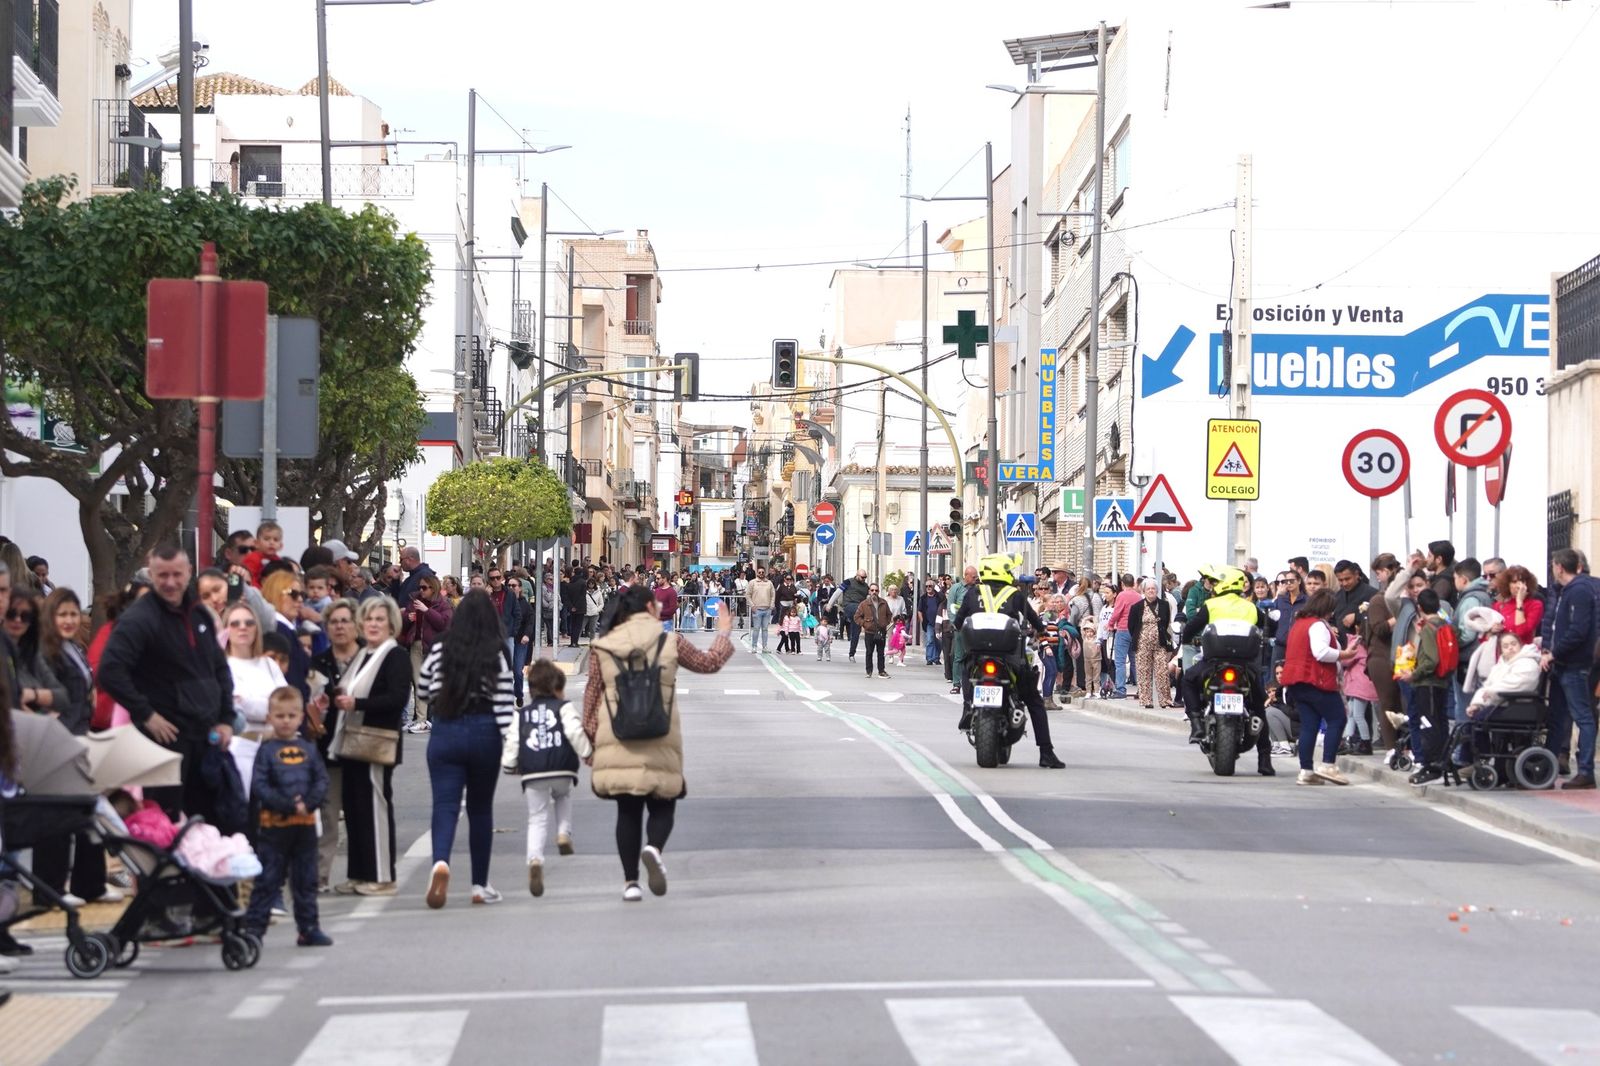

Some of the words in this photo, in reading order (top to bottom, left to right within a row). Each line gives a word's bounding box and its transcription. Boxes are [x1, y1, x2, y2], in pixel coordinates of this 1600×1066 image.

[1216, 303, 1325, 322] Eosición
[1332, 309, 1343, 326] y
[1347, 305, 1404, 323] Venta
[1217, 345, 1396, 390] uebles
[1487, 377, 1529, 396] 950
[1041, 353, 1055, 461] MUEBLES
[1211, 423, 1258, 434] ATENCIÓN
[1357, 451, 1396, 474] 30
[1002, 466, 1053, 480] VERA
[1210, 485, 1256, 495] COLEGIO
[1071, 493, 1083, 510] L
[981, 687, 1001, 697] 8367
